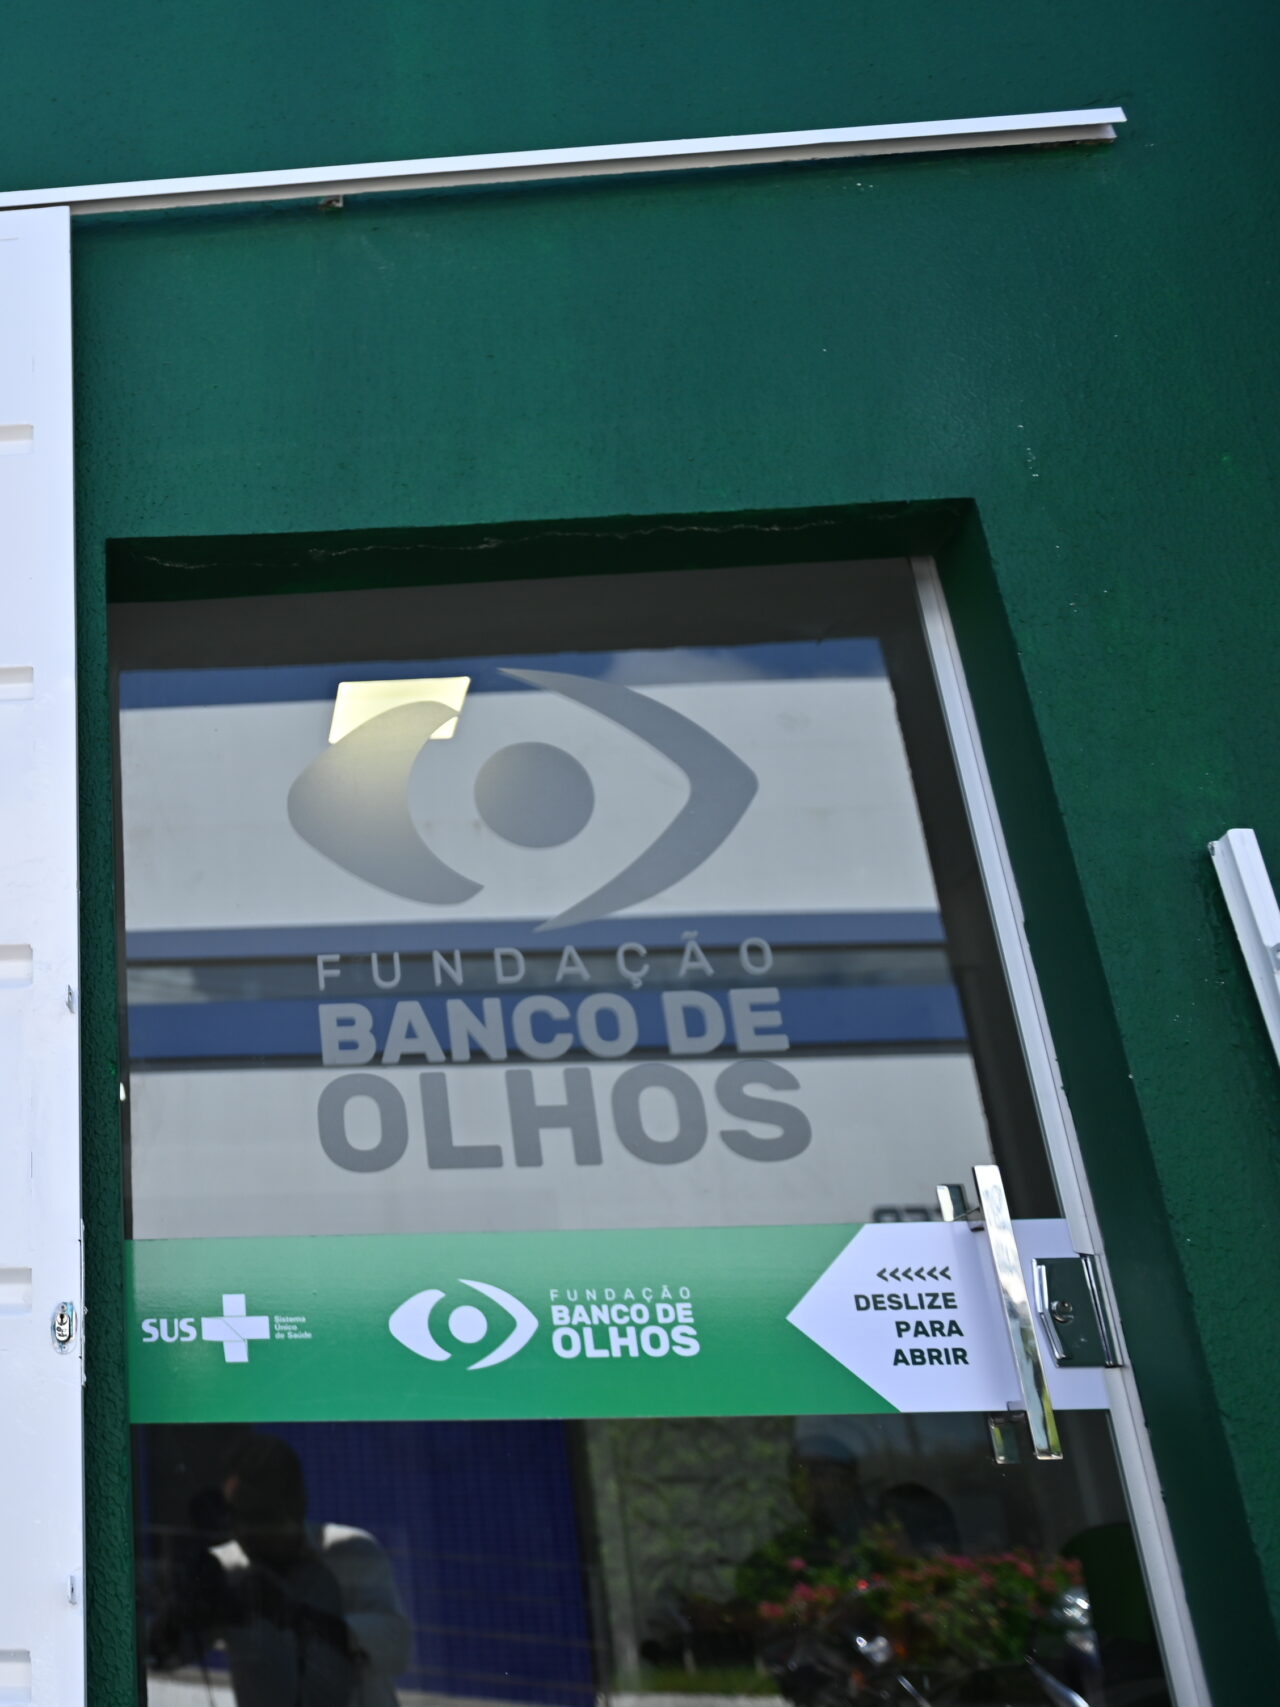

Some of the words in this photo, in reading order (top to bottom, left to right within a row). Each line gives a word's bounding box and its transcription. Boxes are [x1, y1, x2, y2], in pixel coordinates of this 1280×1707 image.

[316, 931, 774, 991] FUNDAÇÃO
[318, 993, 639, 1066] BANCO
[661, 986, 790, 1055] DE
[317, 1059, 812, 1173] OLHOS
[549, 1284, 691, 1303] FUNDAÇÃO
[853, 1291, 958, 1312] DESLIZE
[274, 1315, 306, 1323] Sistema
[550, 1302, 651, 1326] BANCO
[654, 1302, 695, 1324] DE
[141, 1317, 198, 1343] SUS
[275, 1331, 285, 1339] de
[894, 1319, 965, 1338] PARA
[551, 1324, 701, 1359] OLHOS
[892, 1347, 969, 1367] ABRIR
